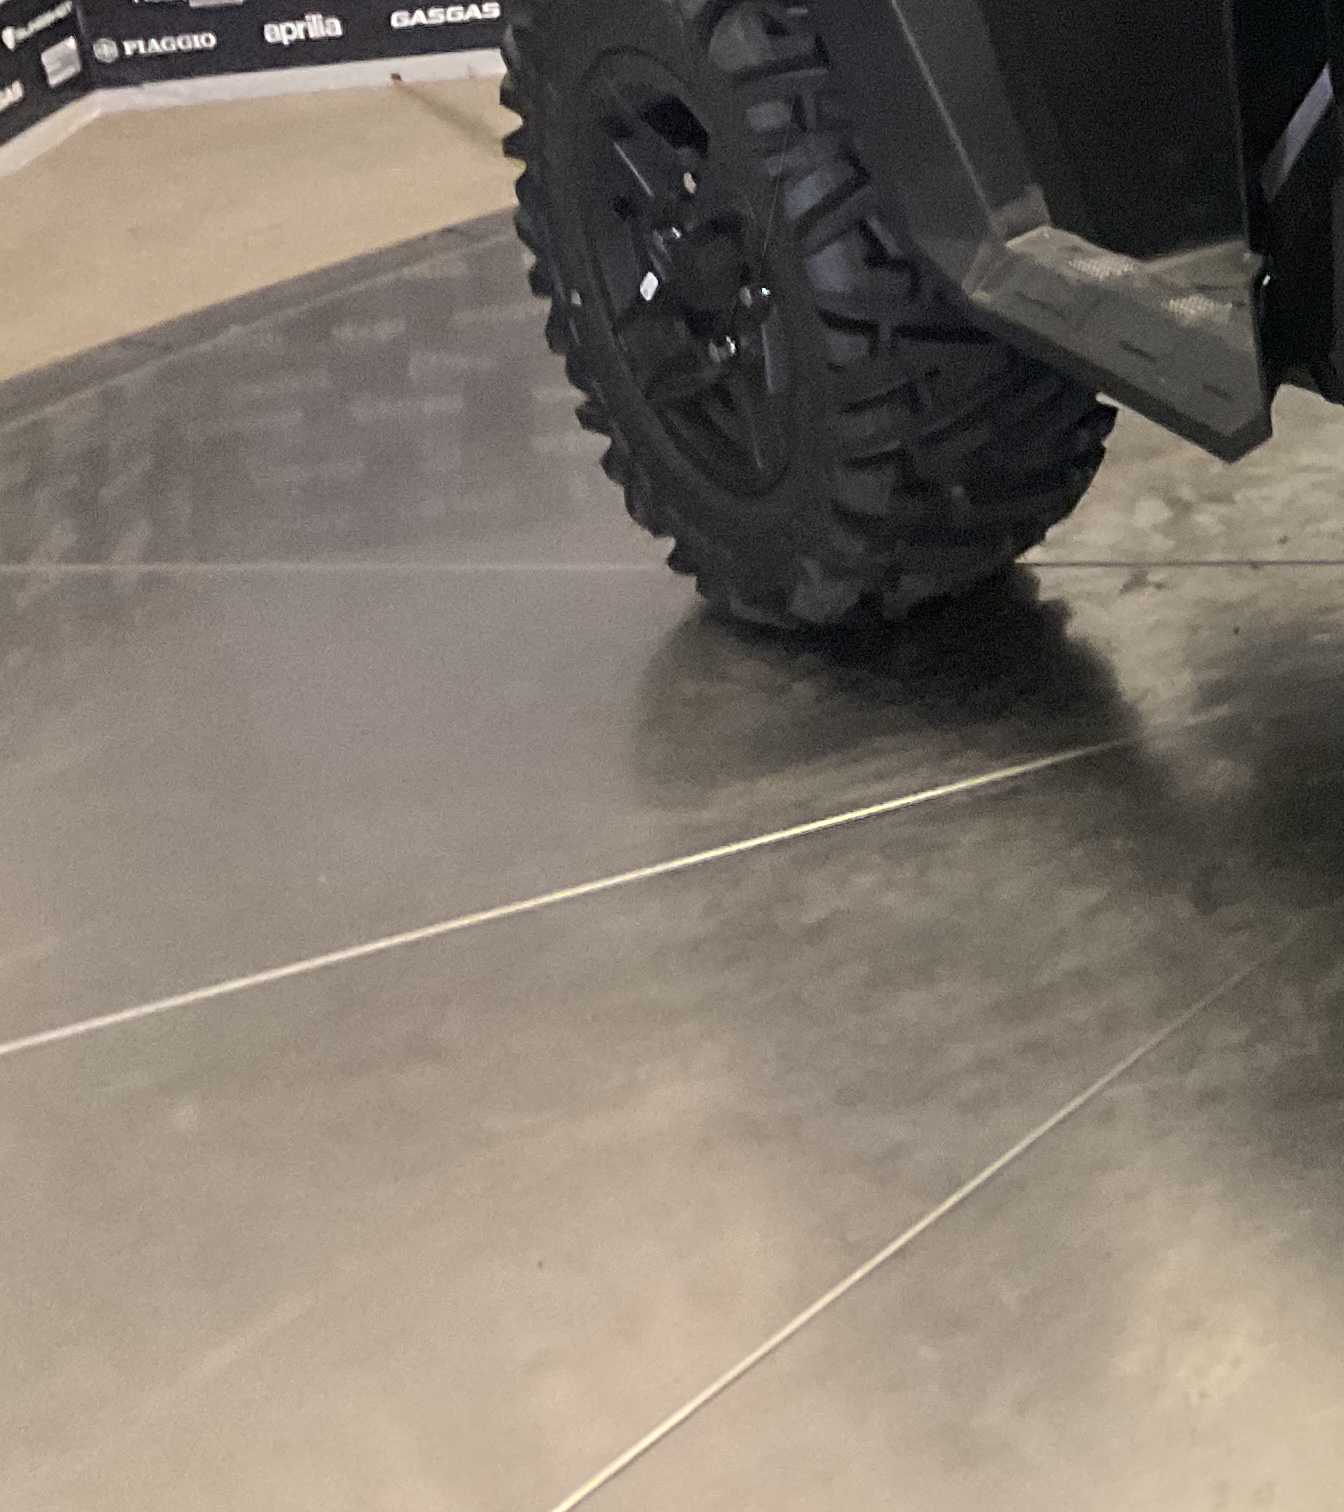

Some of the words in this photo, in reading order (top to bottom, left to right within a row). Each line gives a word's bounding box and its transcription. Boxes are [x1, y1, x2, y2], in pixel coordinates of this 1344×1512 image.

[264, 13, 343, 45] aprilia
[391, 2, 500, 29] GASGAS
[123, 33, 217, 57] PIAGGIO
